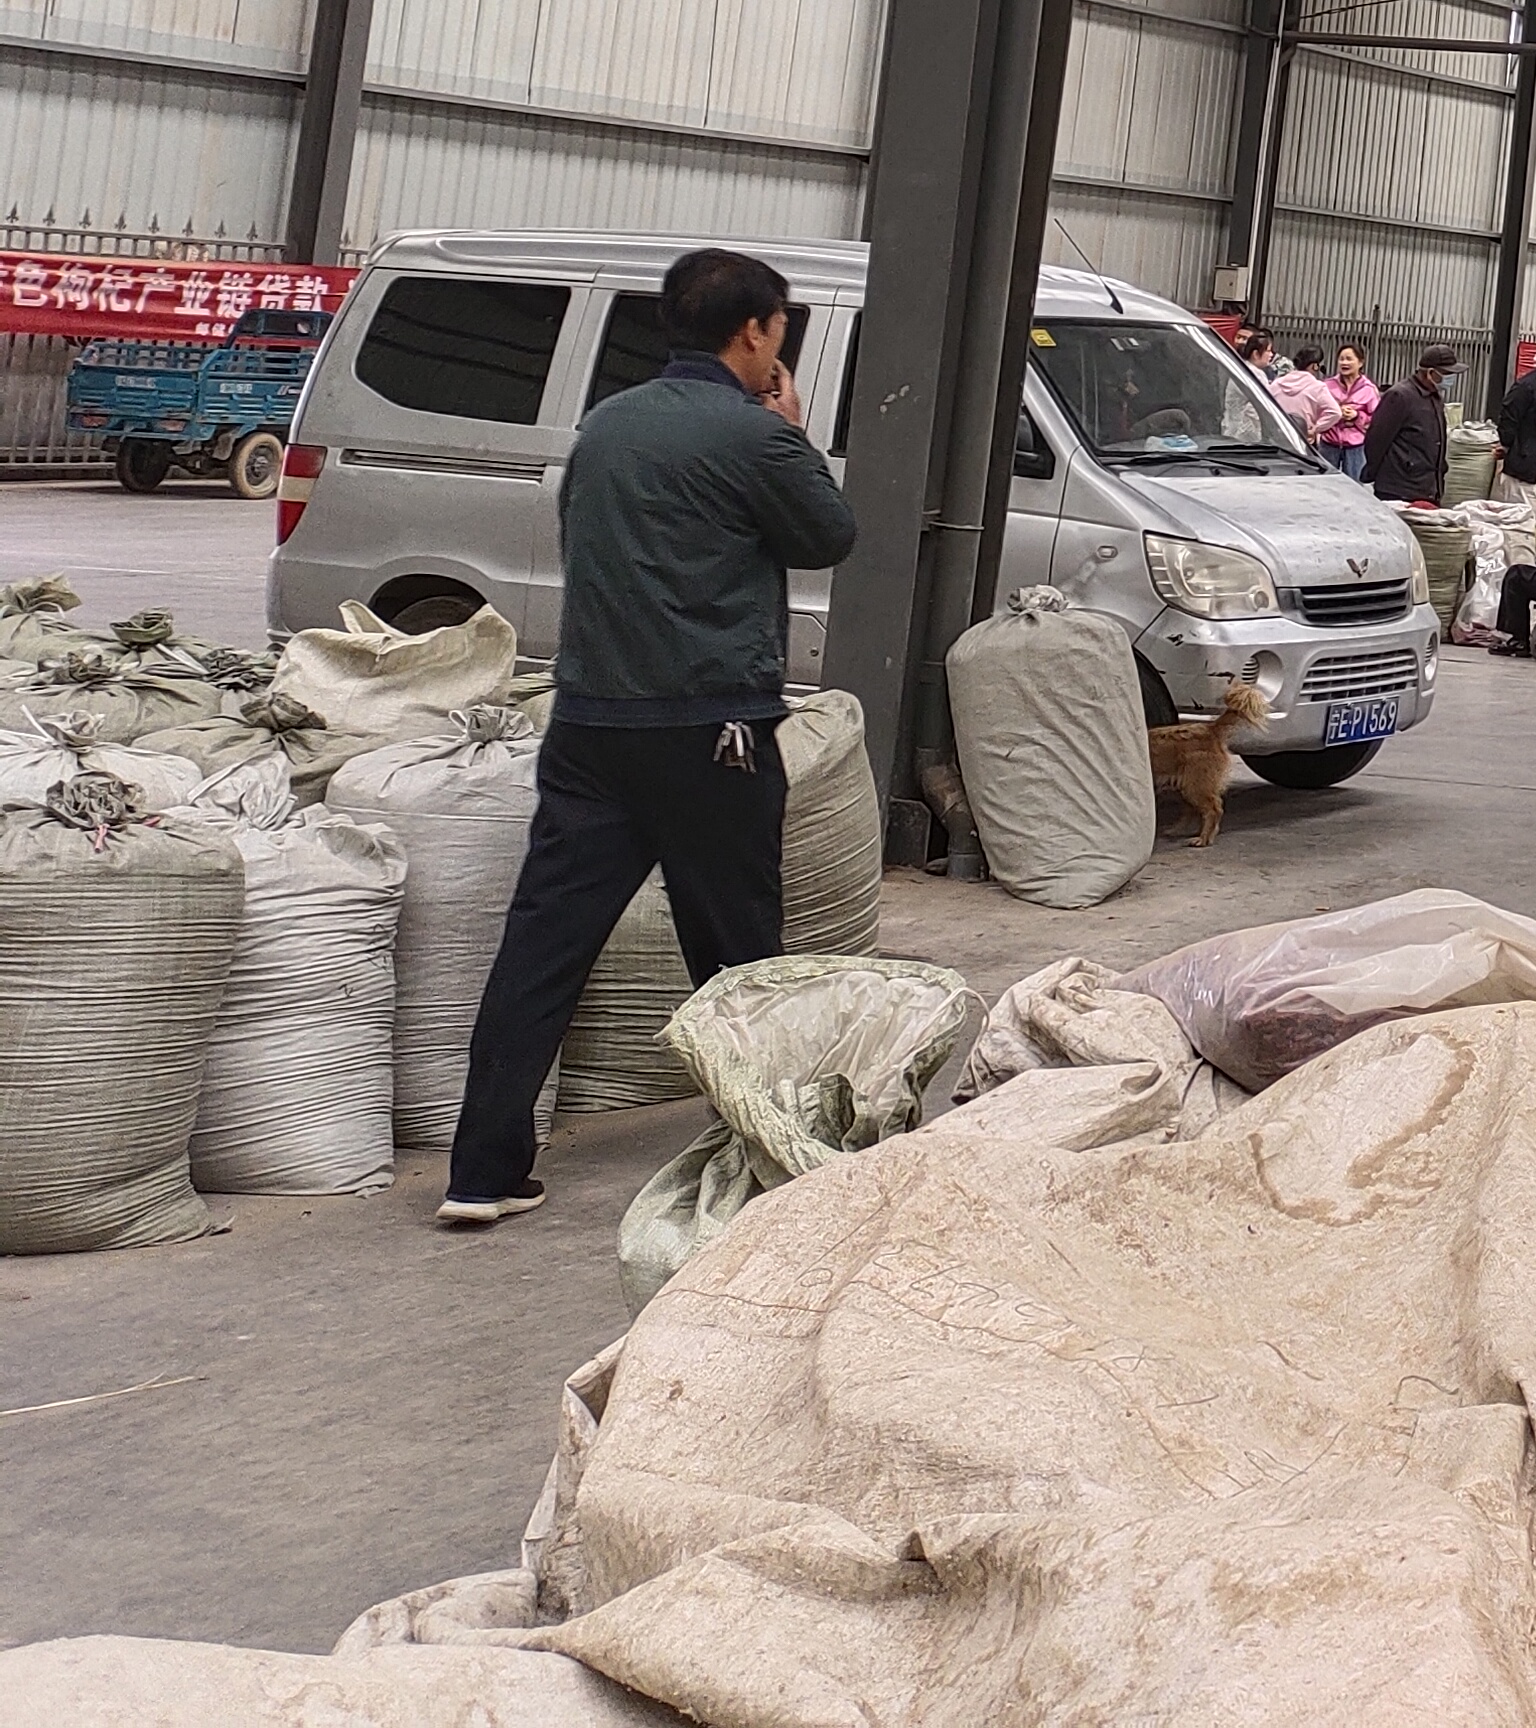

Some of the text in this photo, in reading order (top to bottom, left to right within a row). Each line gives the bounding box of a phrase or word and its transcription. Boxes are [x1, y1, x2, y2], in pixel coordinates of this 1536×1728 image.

[0, 260, 329, 318] 色枸杞产业链贷款
